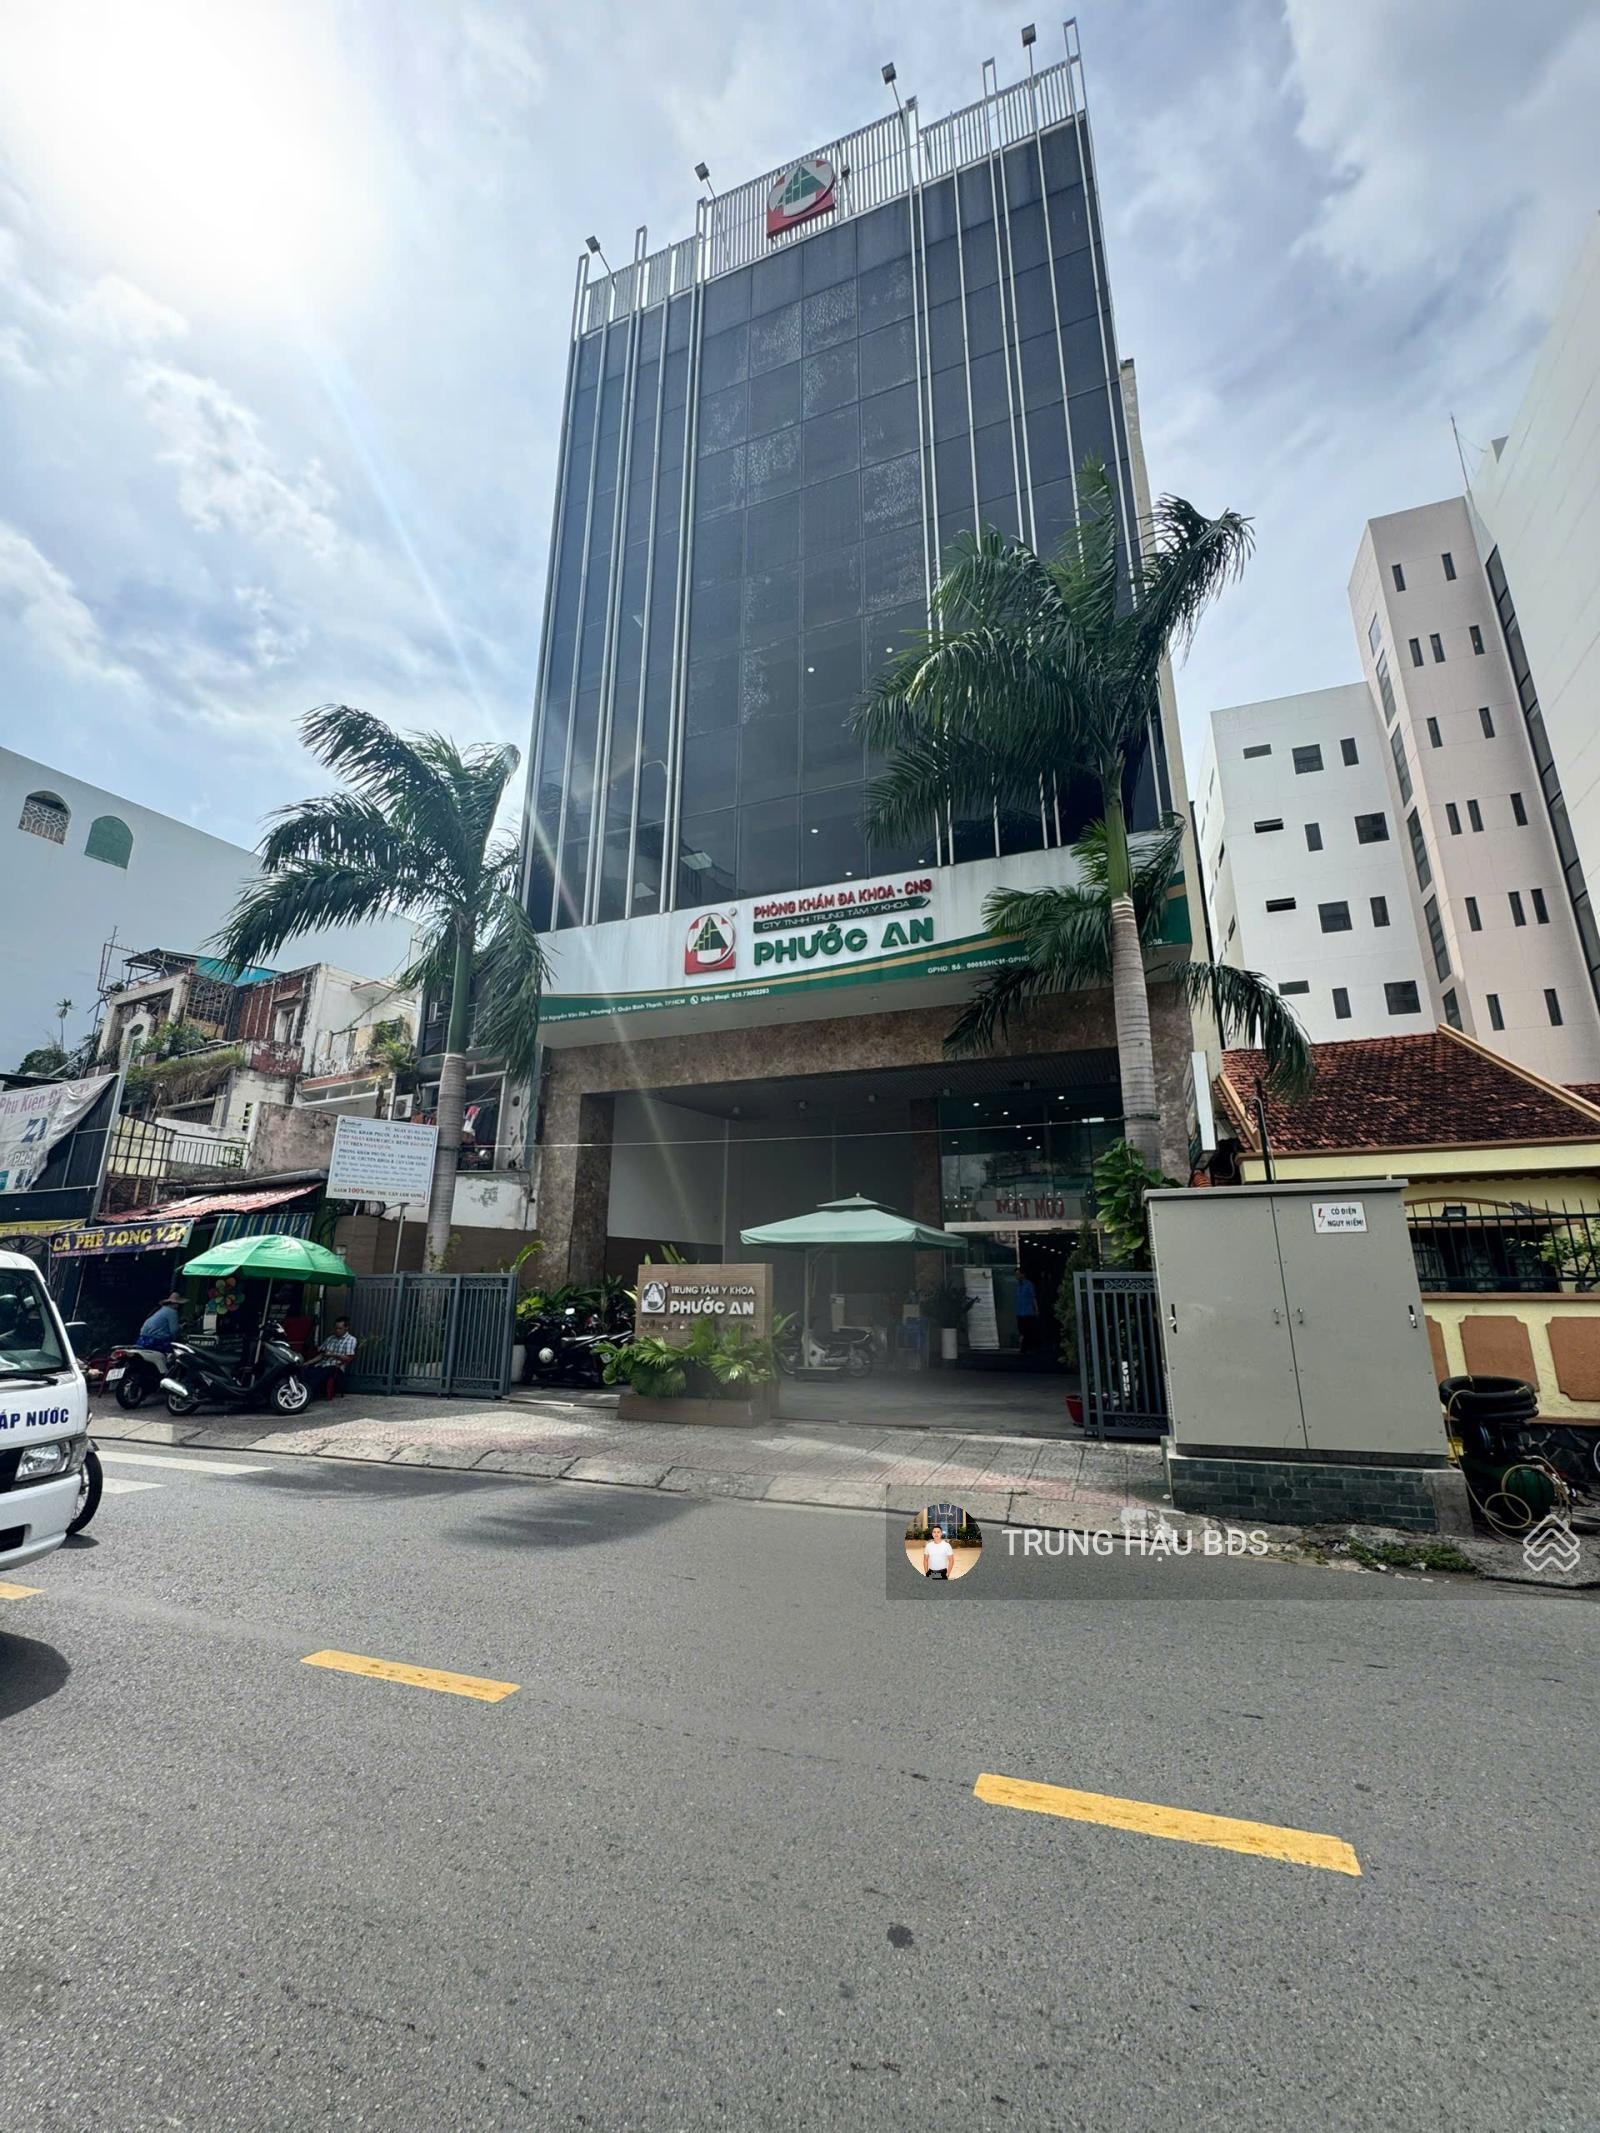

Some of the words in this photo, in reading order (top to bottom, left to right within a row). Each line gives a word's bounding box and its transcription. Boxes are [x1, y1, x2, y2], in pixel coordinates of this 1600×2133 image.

[753, 901, 796, 919] PHÒNG
[798, 893, 835, 913] KHÁM
[837, 890, 856, 907] ĐA
[858, 886, 895, 904] KHOA
[762, 920, 782, 930] CTY
[784, 915, 811, 926] TNHH
[811, 911, 845, 922] TRUNG
[847, 905, 870, 917] TÂM
[881, 900, 911, 911] KHOA
[754, 923, 868, 966] PHƯỚC
[881, 917, 934, 948] AN
[74, 1229, 105, 1249] PHÊ
[106, 1229, 152, 1247] LONG
[671, 1285, 698, 1294] TRUNG
[700, 1284, 719, 1294] TÂM
[721, 1286, 728, 1294] Y
[730, 1286, 755, 1295] KHOA
[669, 1296, 725, 1315] PHƯỚC
[729, 1301, 755, 1315] AN
[26, 1406, 69, 1427] NƯỚC
